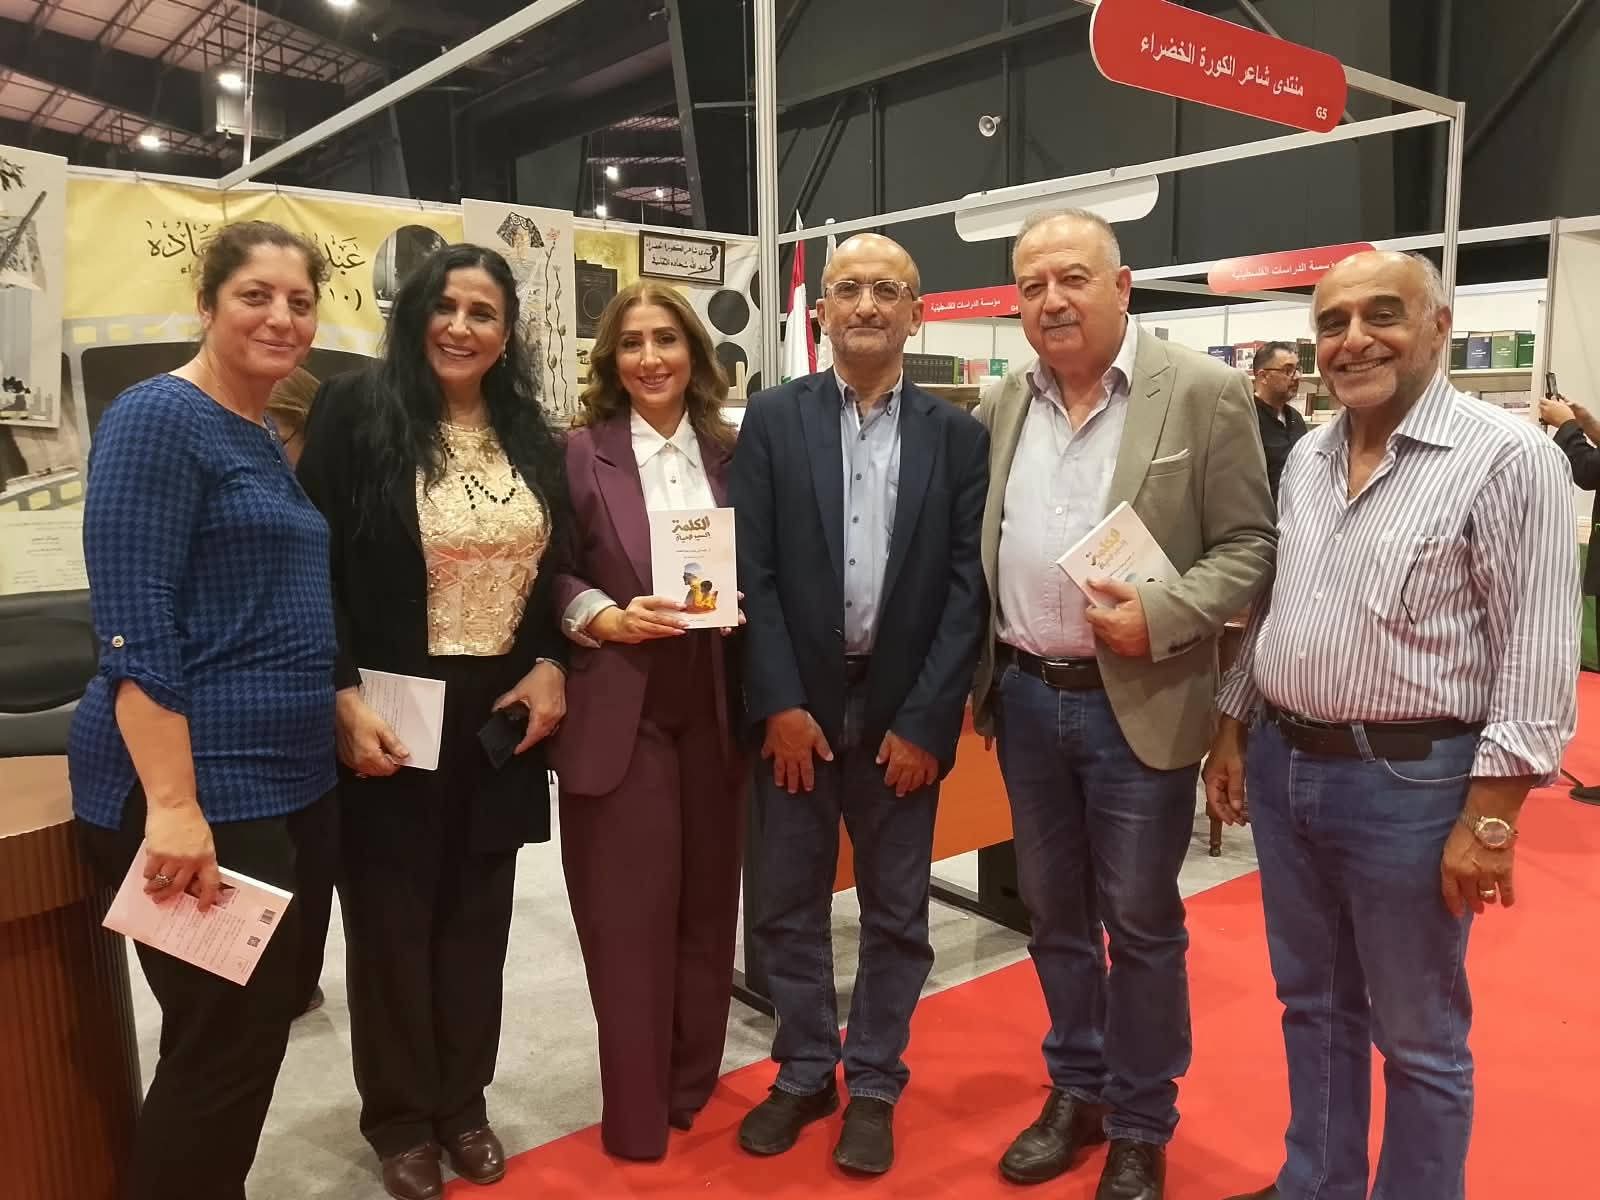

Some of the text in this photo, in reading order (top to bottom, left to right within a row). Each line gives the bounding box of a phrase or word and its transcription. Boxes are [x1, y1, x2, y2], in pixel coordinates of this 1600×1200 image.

[1140, 31, 1304, 97] منتدى شاعر الكورة الخضراء
[1315, 106, 1328, 120] G5
[1271, 261, 1307, 276] الدراسات
[930, 297, 1001, 313] مؤسسة الدراسات الفلسطينية
[671, 515, 711, 534] الكلمة
